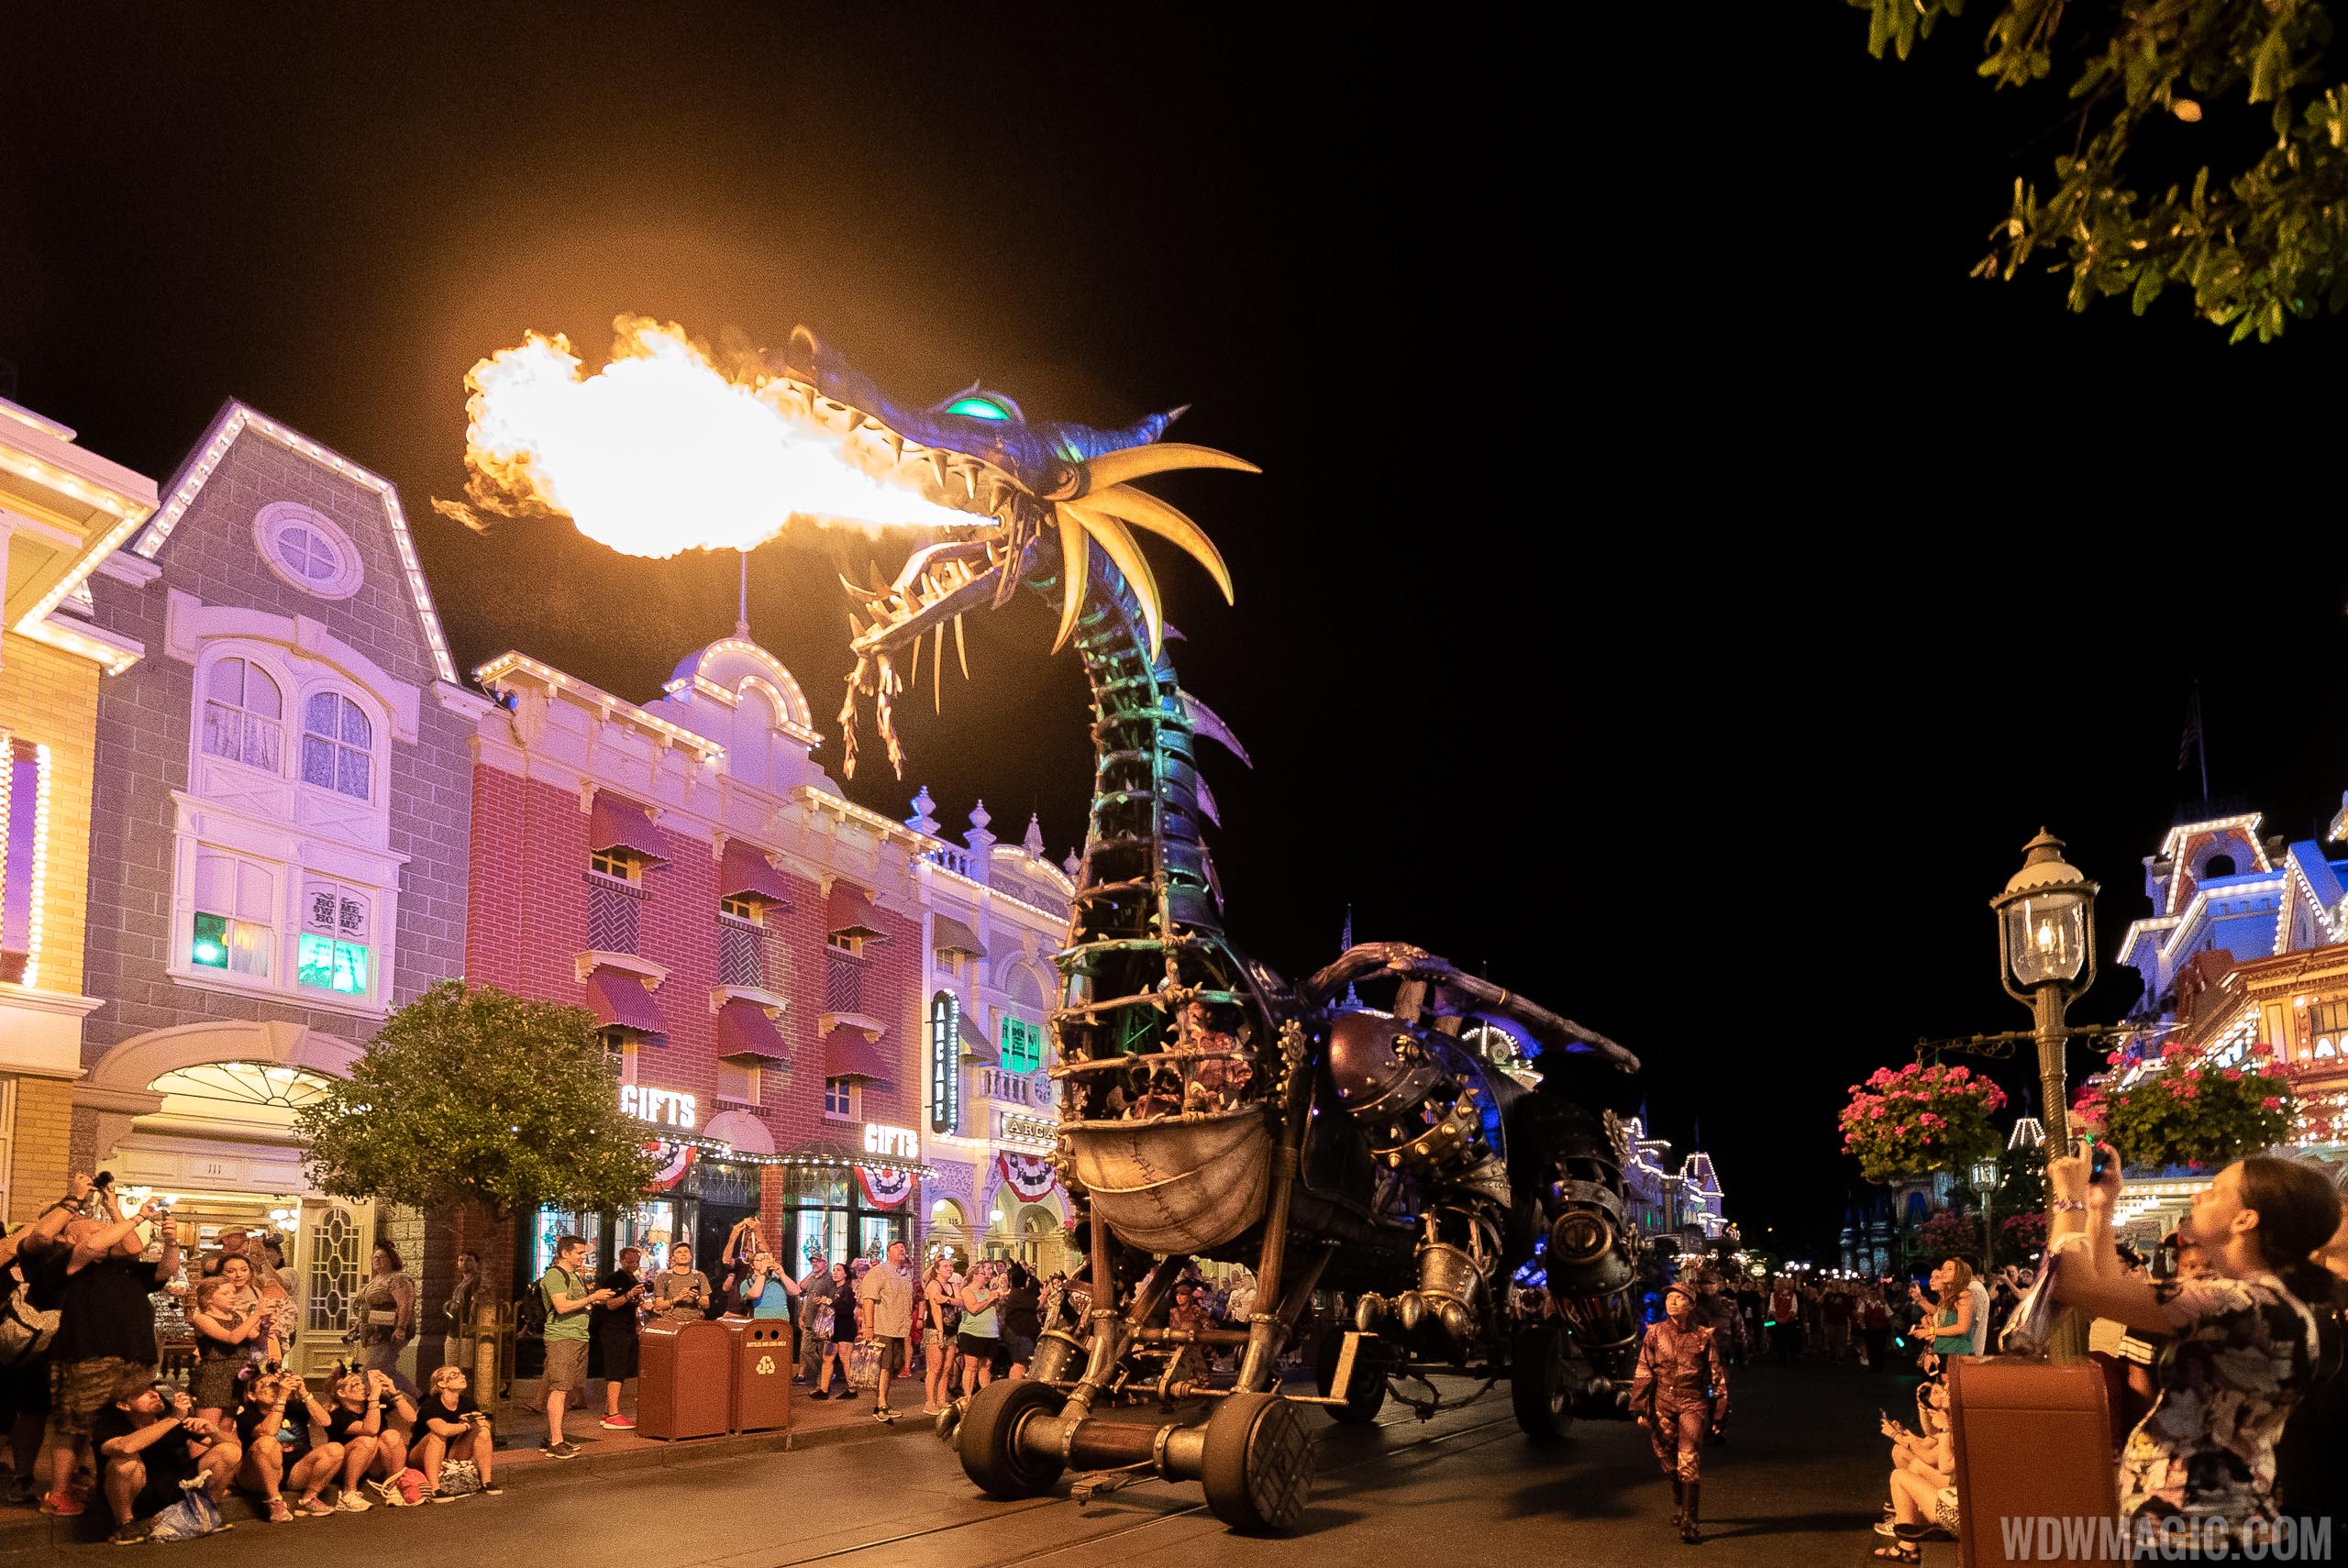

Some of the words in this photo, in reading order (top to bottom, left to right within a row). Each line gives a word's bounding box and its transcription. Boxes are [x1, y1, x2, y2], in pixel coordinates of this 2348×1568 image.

[934, 1001, 946, 1121] ARCADE
[620, 1085, 696, 1129] GIFTS
[865, 1123, 918, 1159] GIFTS
[207, 1164, 222, 1175] 111
